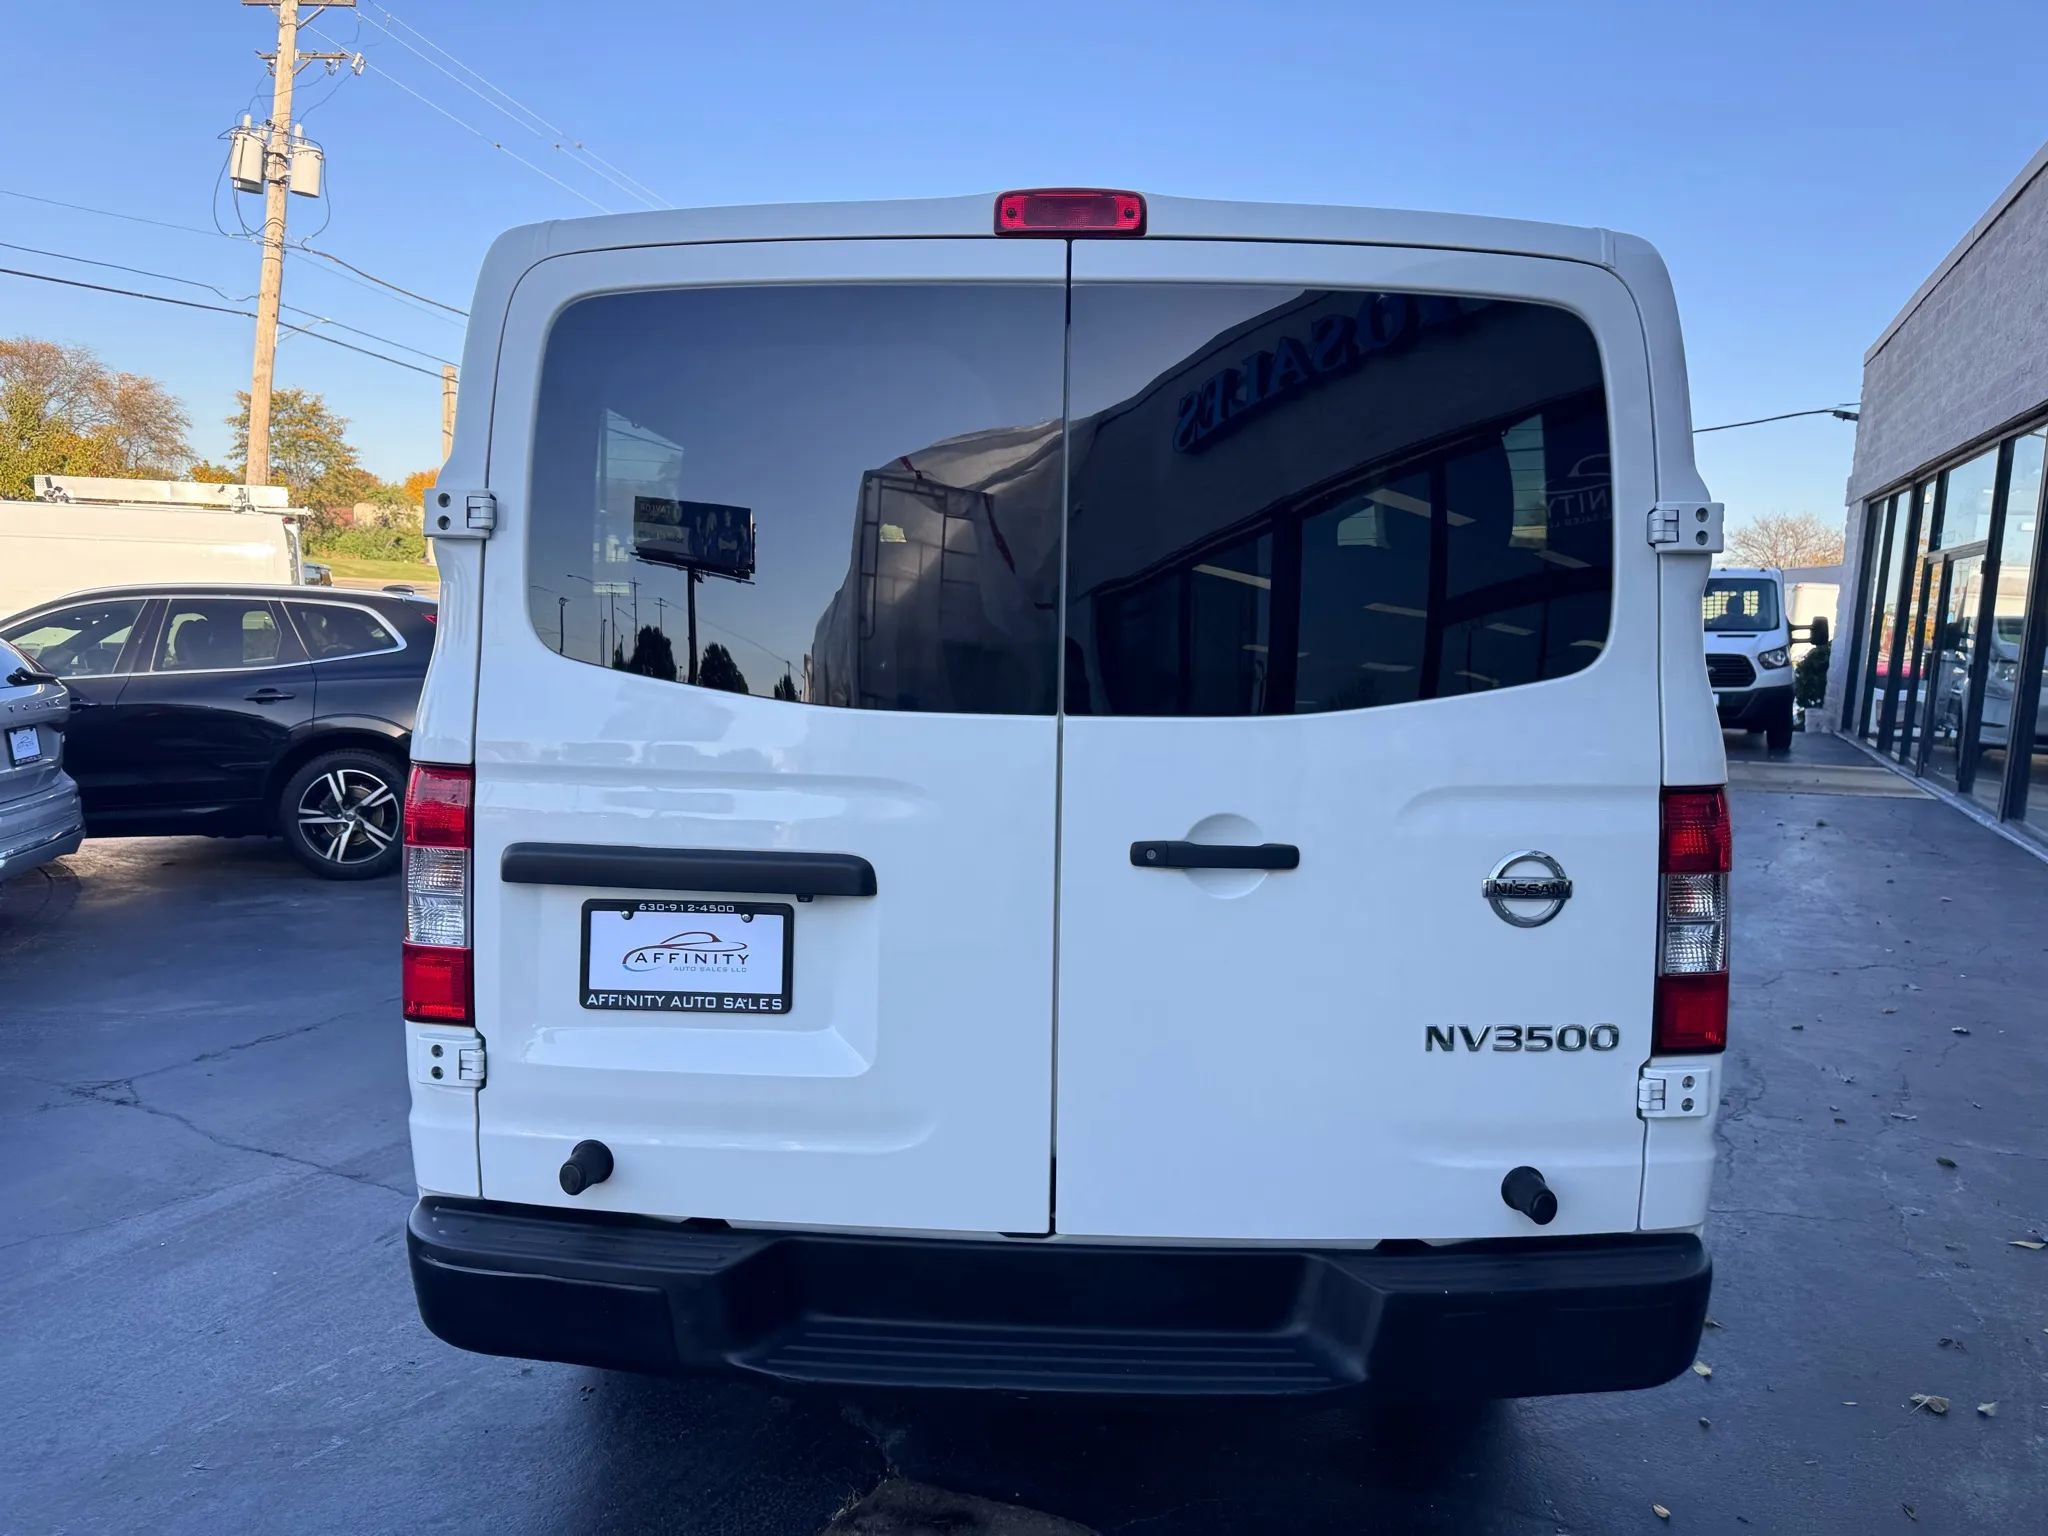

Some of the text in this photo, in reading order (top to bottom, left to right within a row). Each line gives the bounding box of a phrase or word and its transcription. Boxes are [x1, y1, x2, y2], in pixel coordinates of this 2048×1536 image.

[1494, 881, 1566, 895] NISSAN
[638, 903, 735, 913] 630-912-4500
[634, 952, 750, 965] AFFINITY
[586, 993, 782, 1010] AFFINITY AUTO SALES
[1424, 1023, 1620, 1051] NV3500
